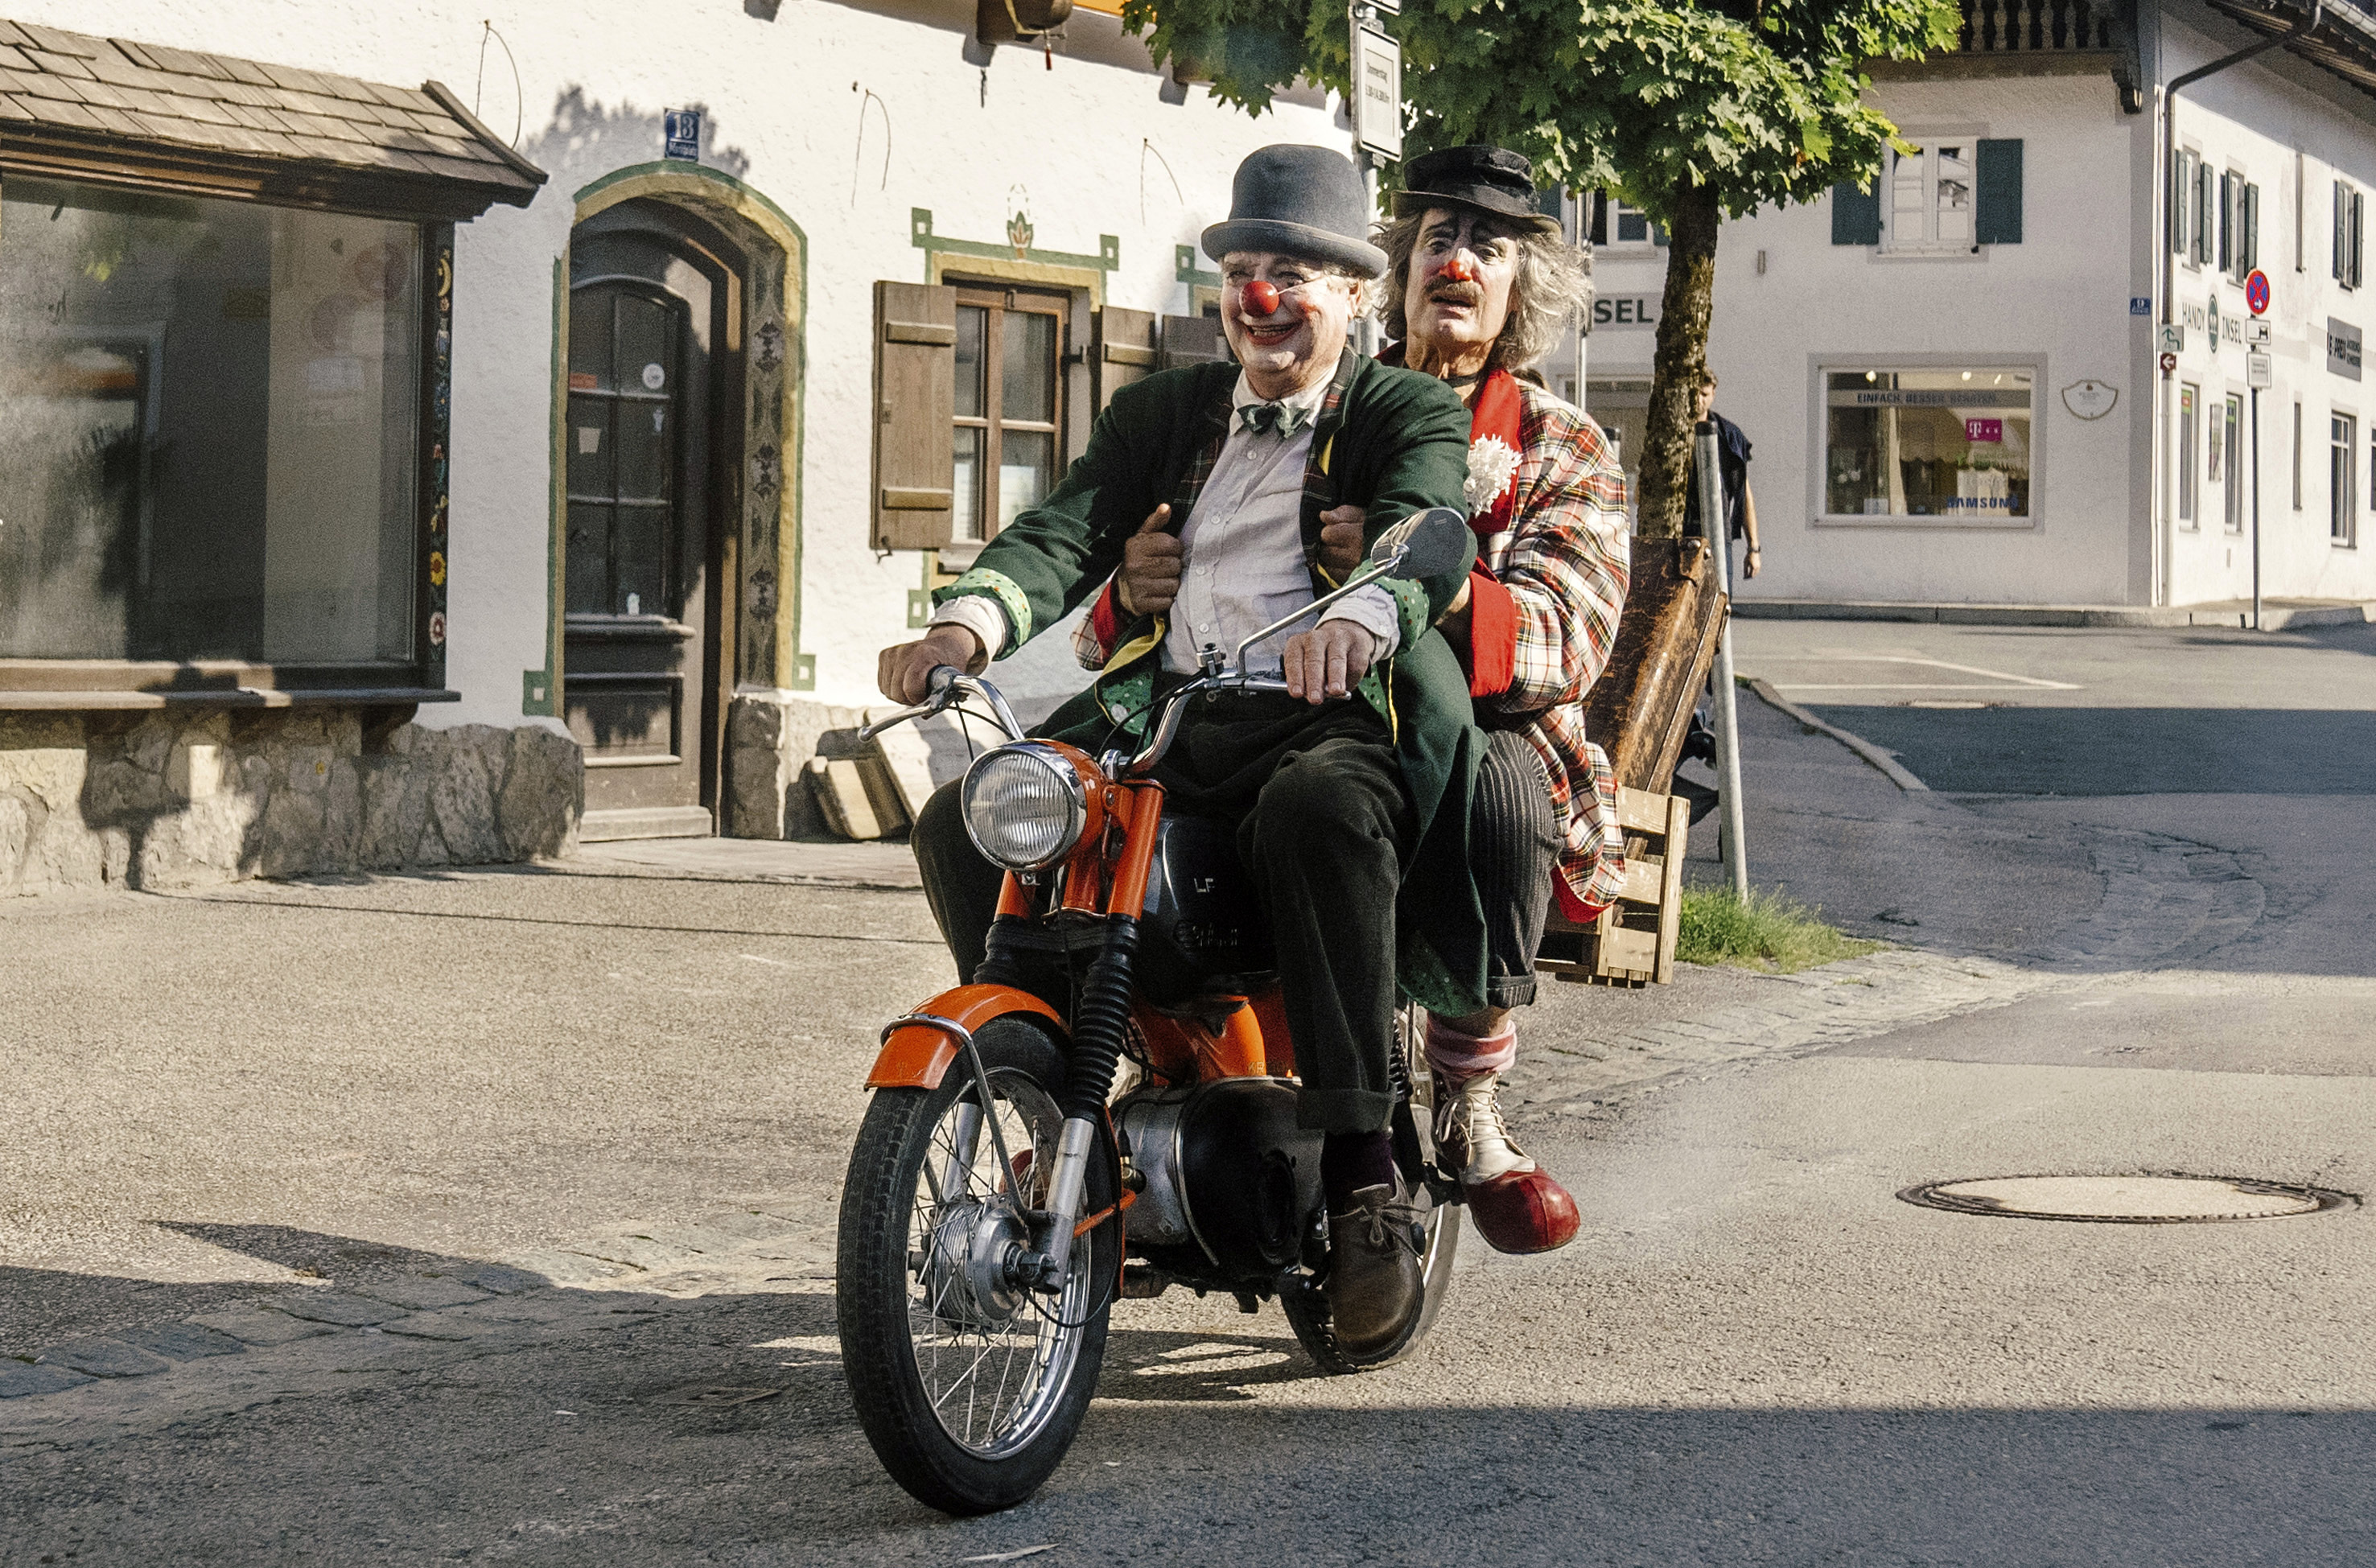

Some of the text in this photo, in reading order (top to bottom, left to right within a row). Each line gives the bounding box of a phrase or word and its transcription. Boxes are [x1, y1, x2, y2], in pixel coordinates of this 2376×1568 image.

[674, 113, 694, 139] 13
[1594, 299, 1654, 323] SEL
[2182, 302, 2242, 344] HANDY INSEL
[1857, 393, 1900, 403] EINFACH
[1905, 393, 1944, 404] BESSER
[1946, 496, 2019, 510] SAMSUNG
